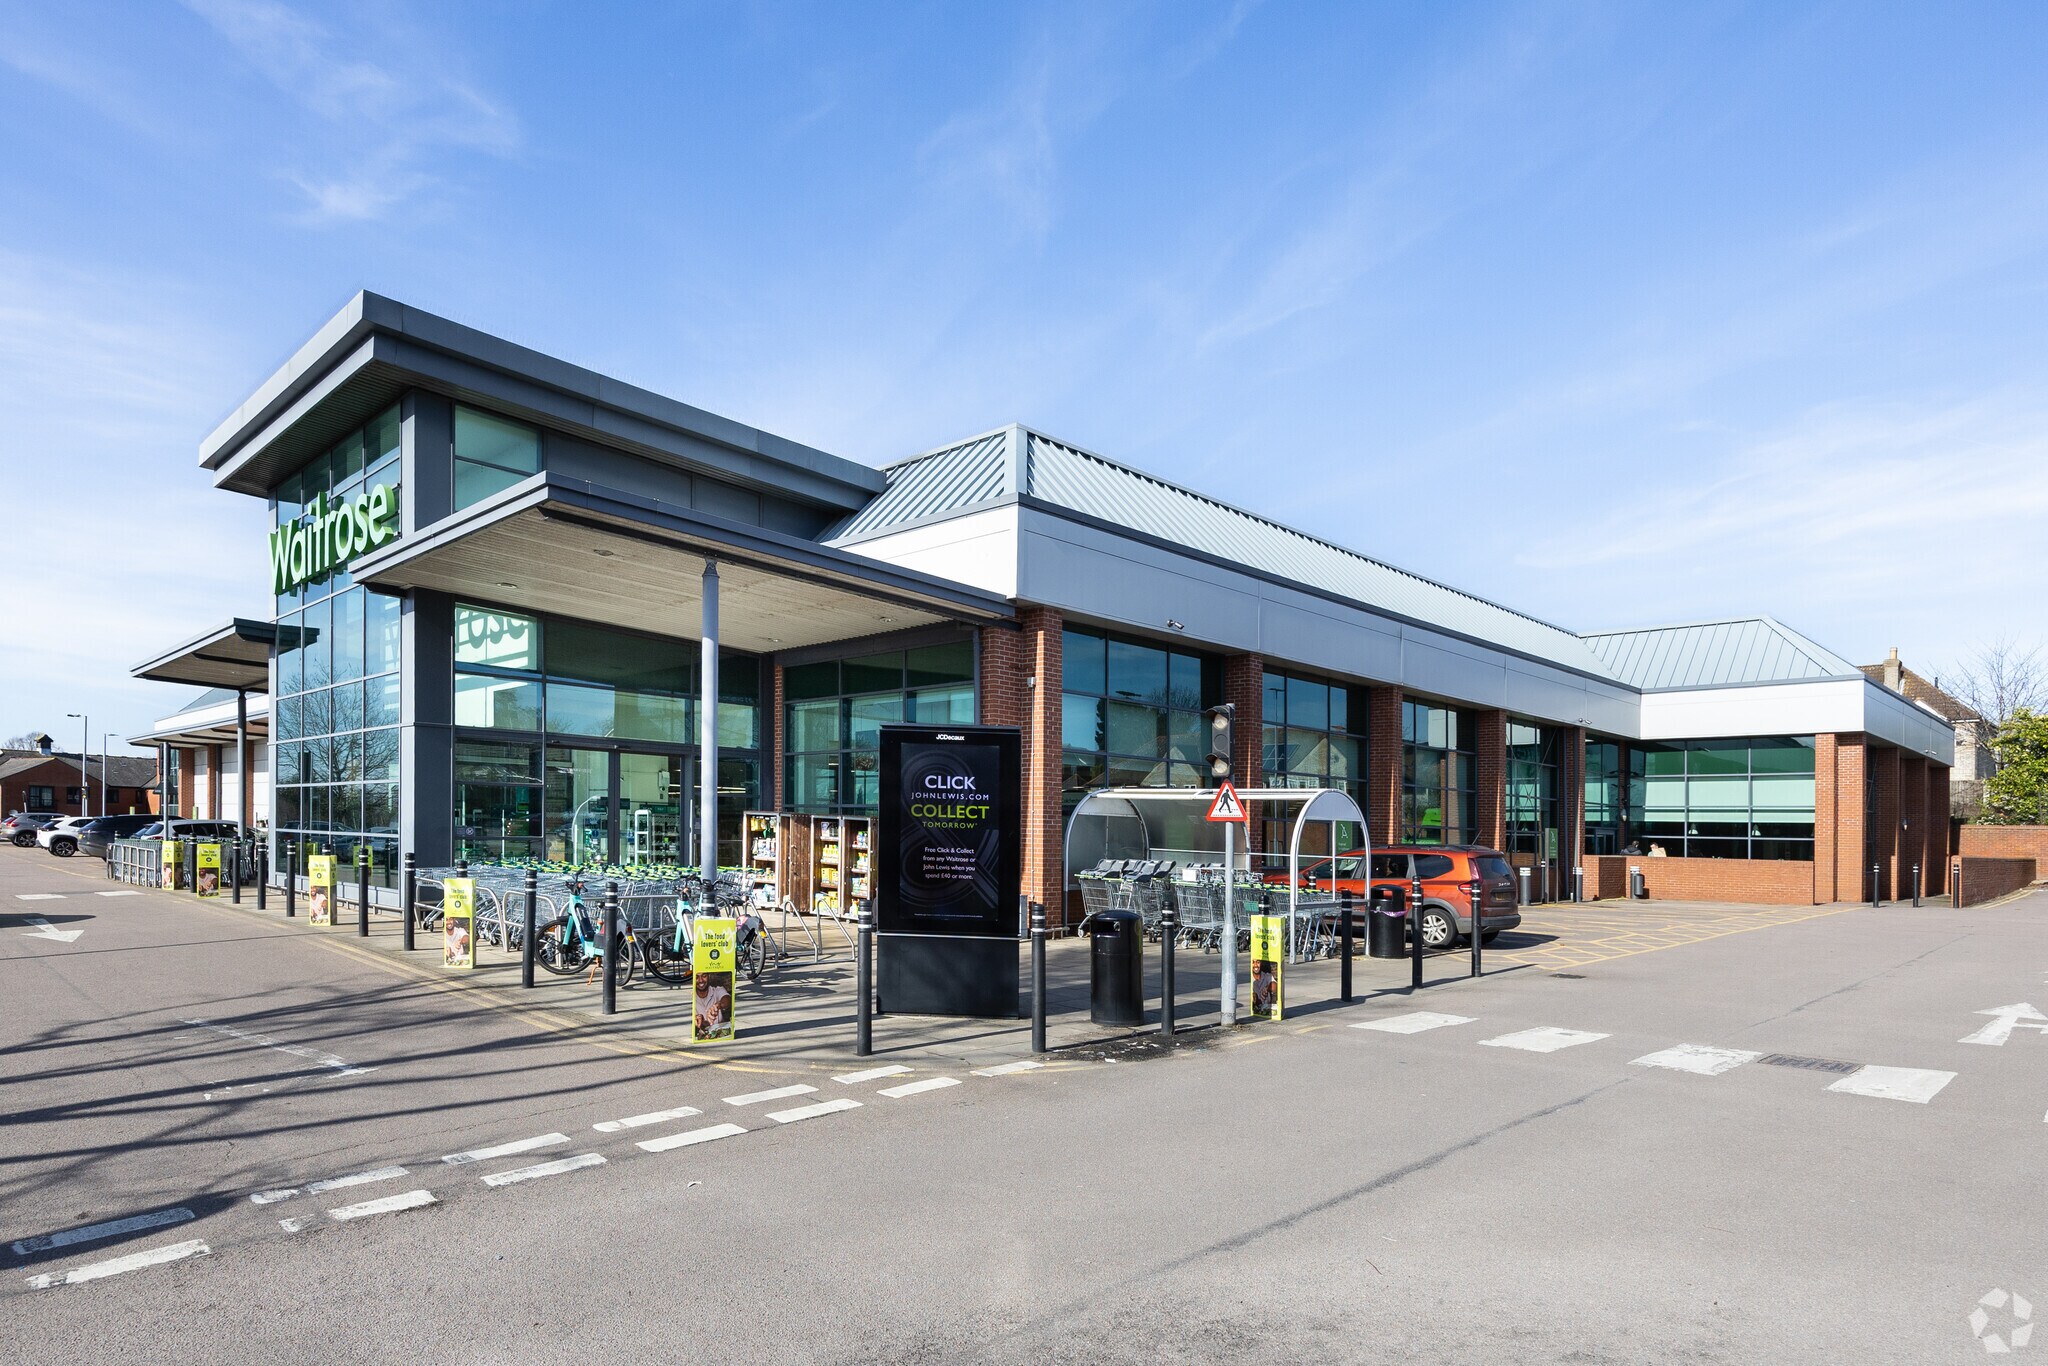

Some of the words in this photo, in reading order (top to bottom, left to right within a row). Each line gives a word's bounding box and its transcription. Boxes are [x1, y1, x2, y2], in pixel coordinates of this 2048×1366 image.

[268, 484, 392, 594] Waitrose
[924, 775, 976, 790] CLICK
[911, 792, 990, 801] JOHNLEWIS.COM
[910, 804, 990, 820] COLLECT
